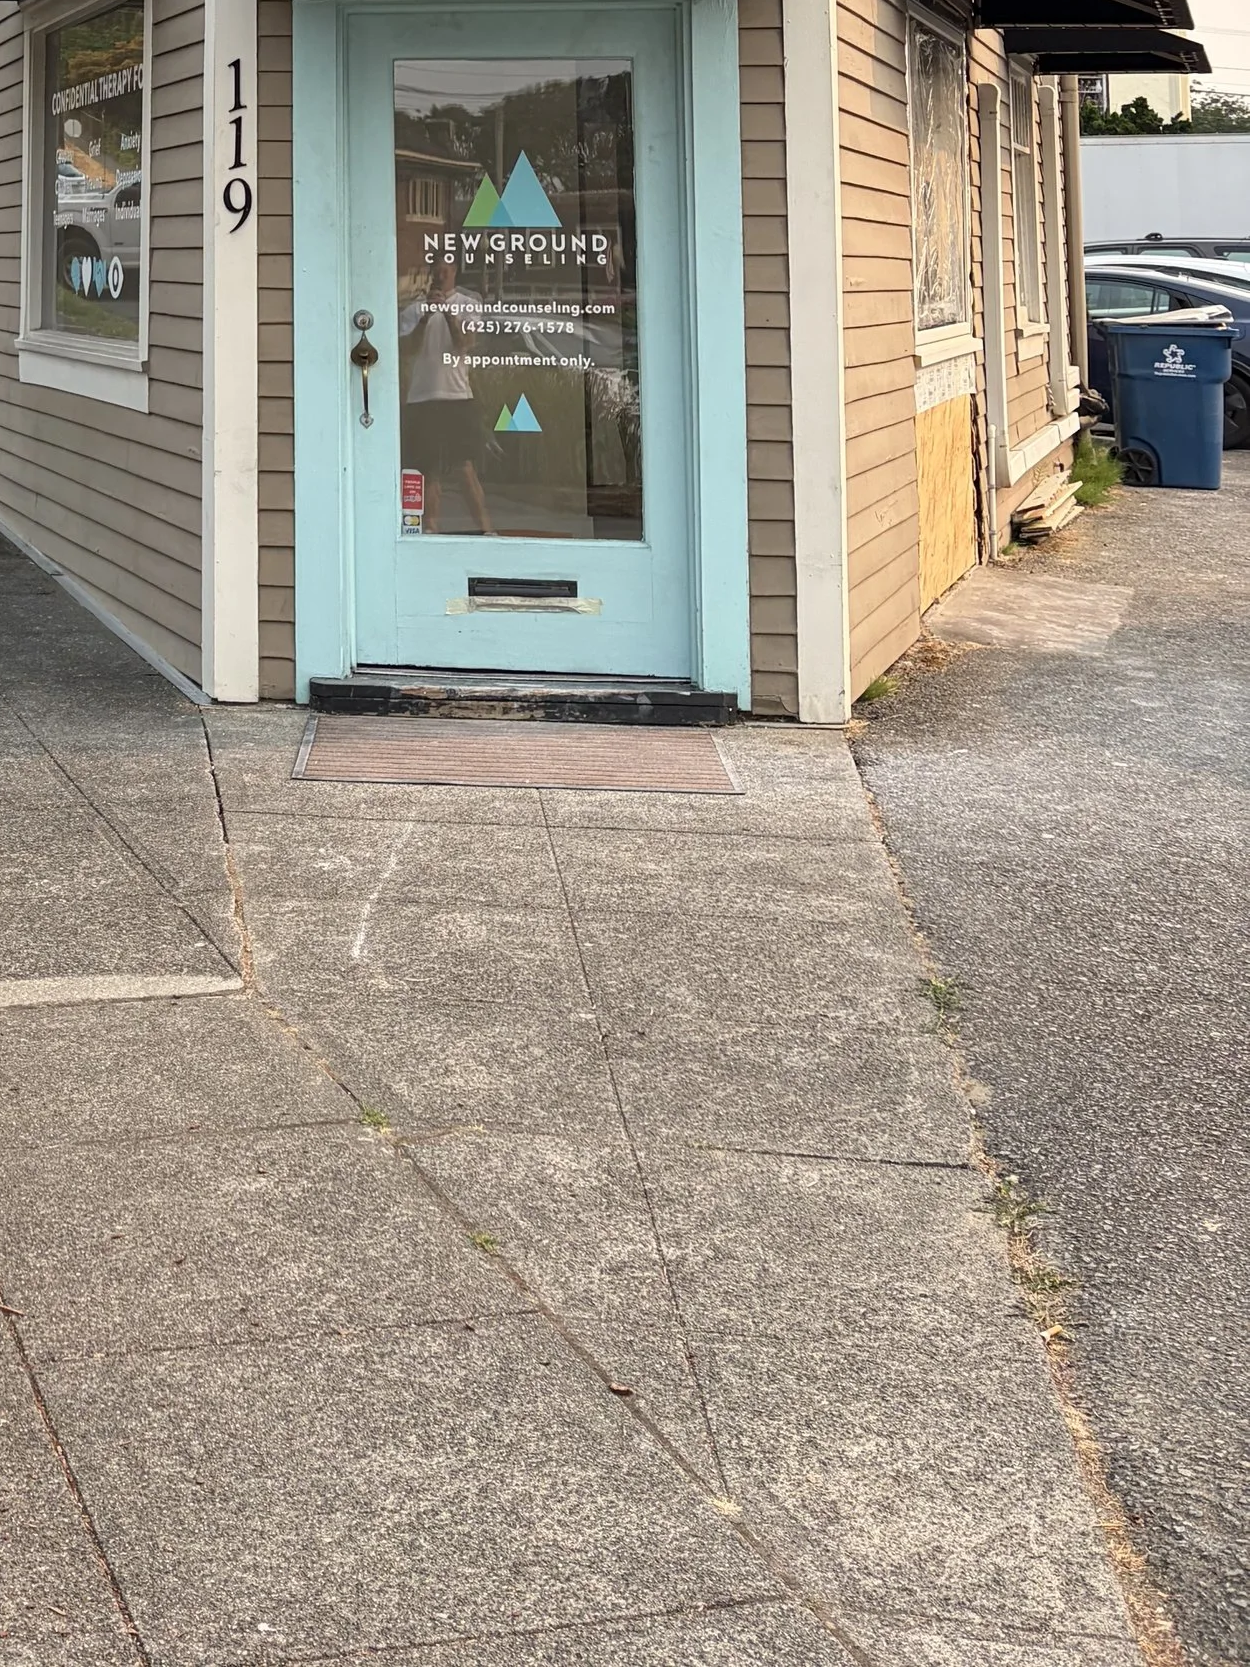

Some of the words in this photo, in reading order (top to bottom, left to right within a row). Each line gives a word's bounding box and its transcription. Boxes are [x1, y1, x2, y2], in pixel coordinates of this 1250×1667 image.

[52, 79, 98, 116] CONFIDENTIAL
[99, 67, 133, 101] THERAPY
[133, 63, 144, 91] FO
[120, 130, 141, 153] Anxiety
[223, 58, 252, 234] 119
[424, 233, 481, 251] NEW
[489, 233, 608, 252] GROUND
[425, 253, 607, 265] COUNSELING
[421, 301, 615, 316] newgroundcounseling.com
[461, 321, 500, 334] (425)
[504, 321, 574, 333] 276-1578
[443, 353, 460, 367] By
[464, 354, 557, 368] appointment
[560, 354, 595, 369] only.
